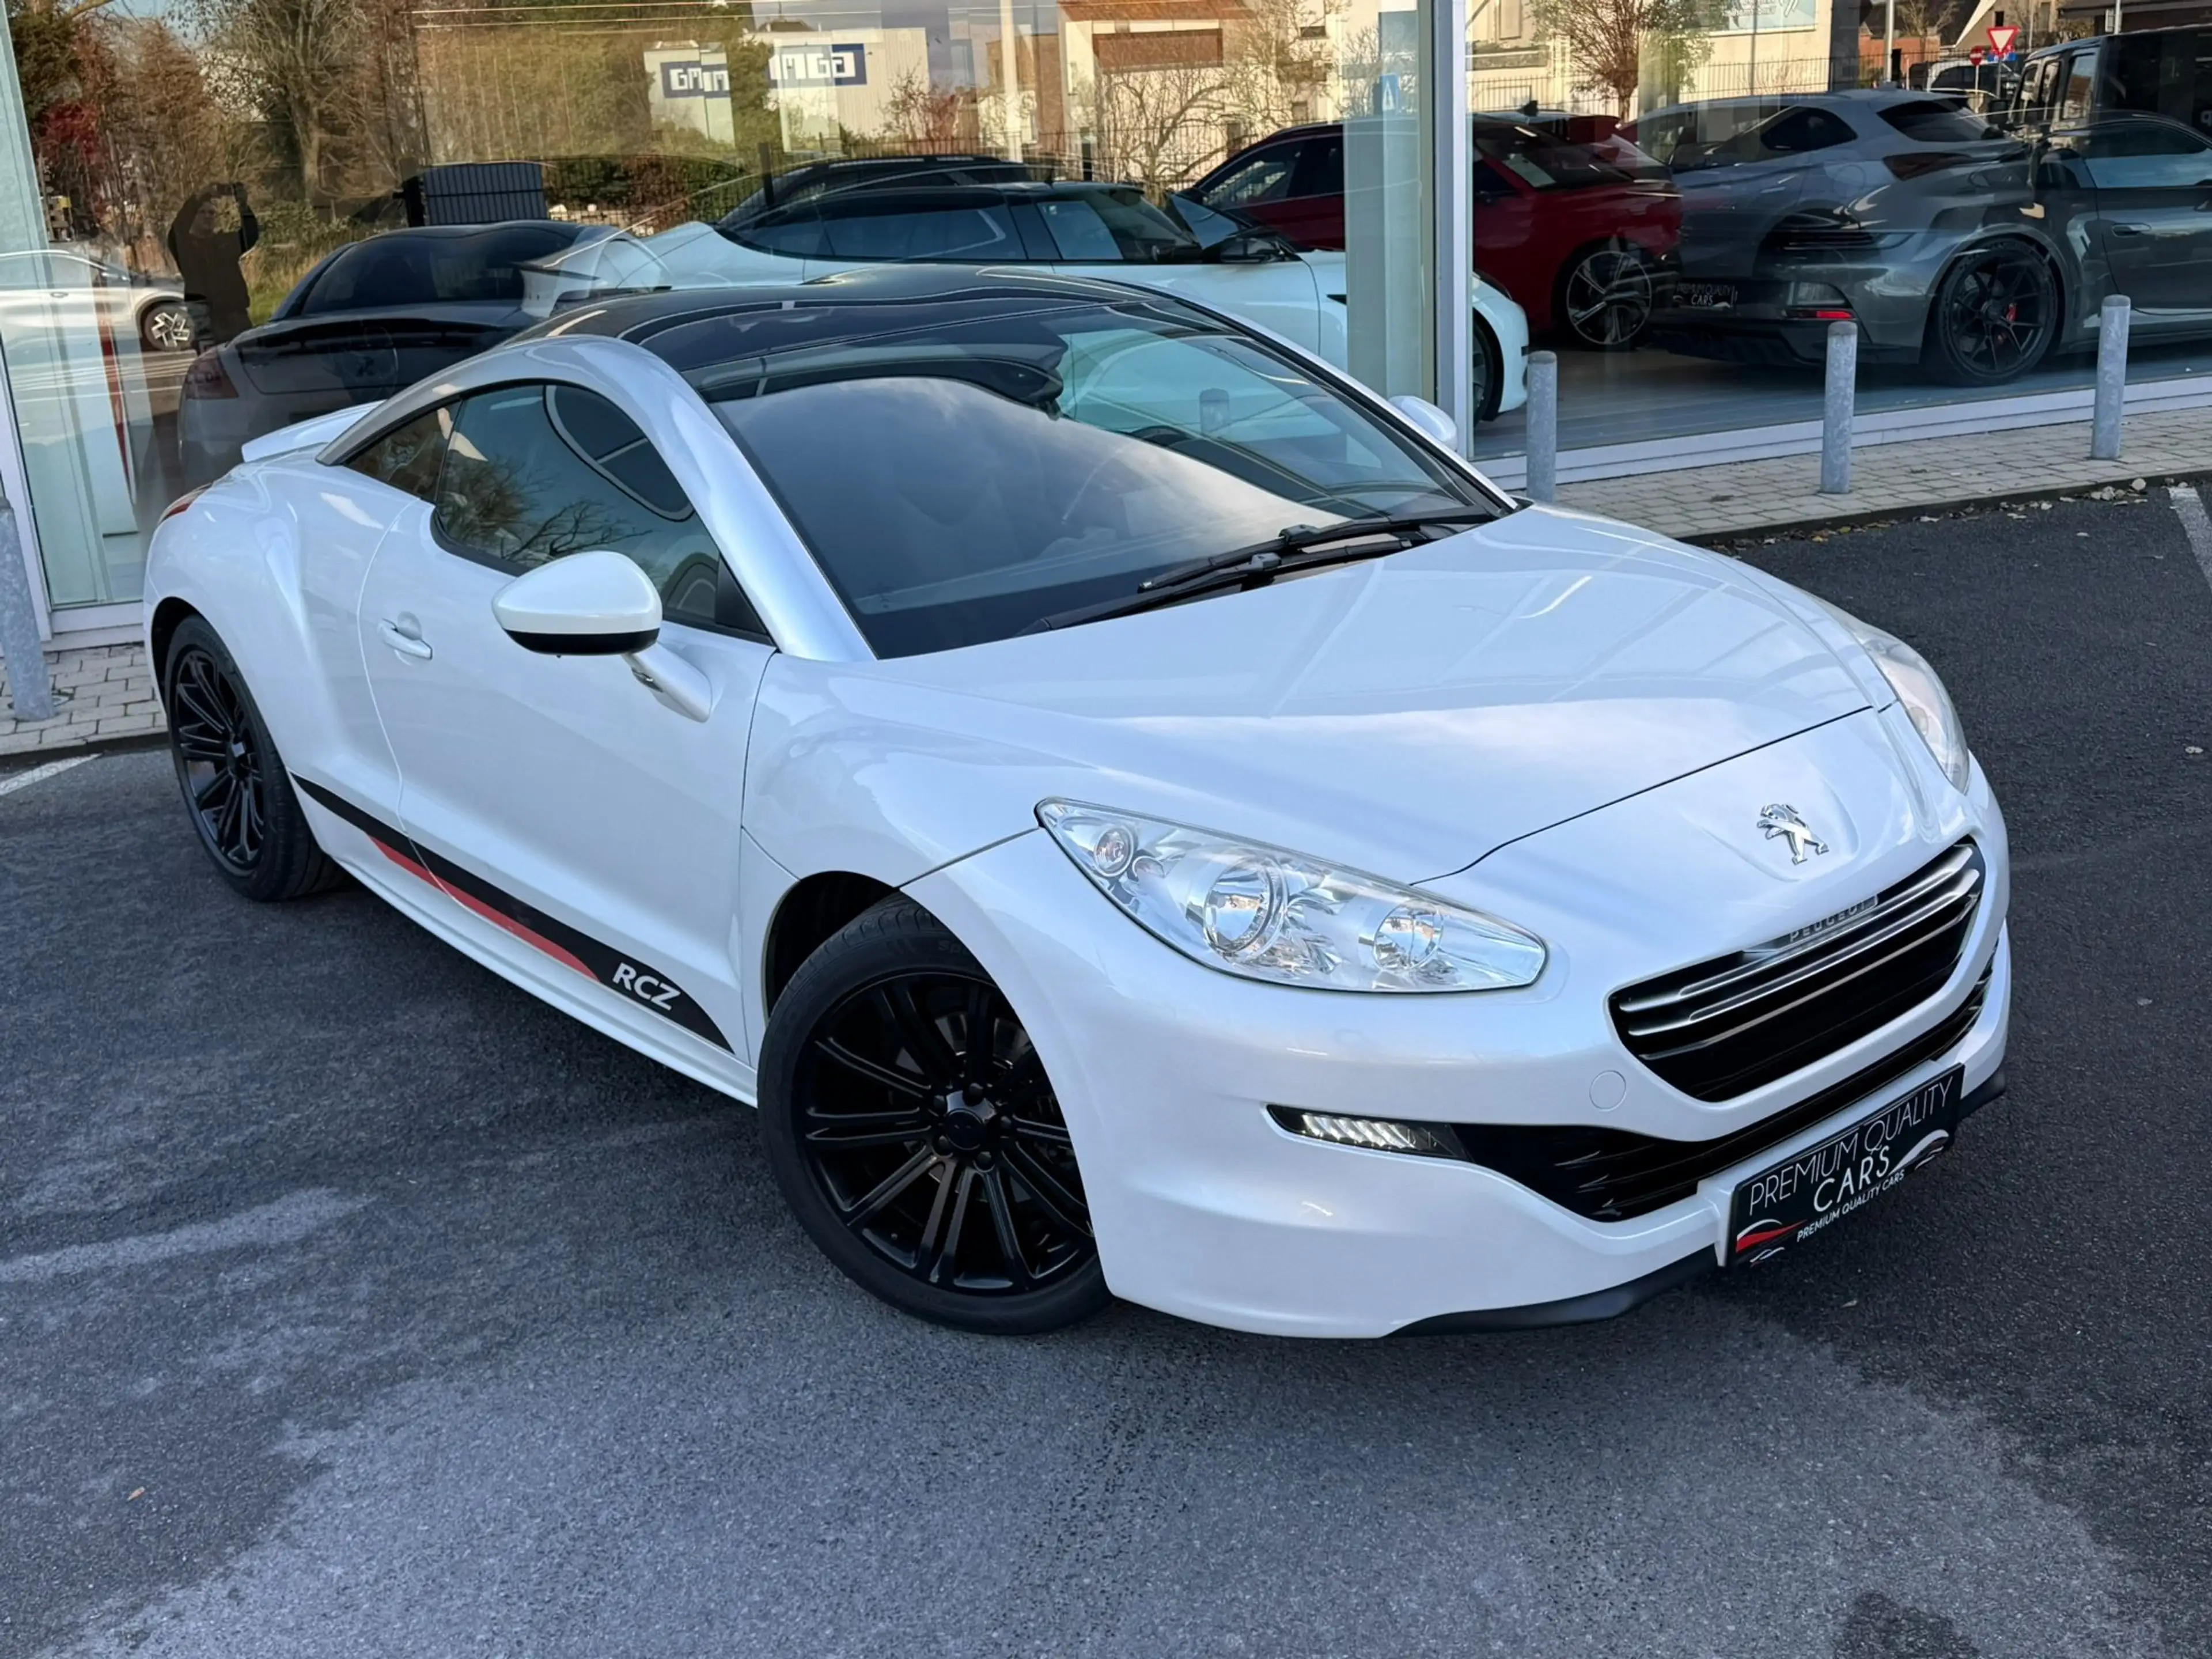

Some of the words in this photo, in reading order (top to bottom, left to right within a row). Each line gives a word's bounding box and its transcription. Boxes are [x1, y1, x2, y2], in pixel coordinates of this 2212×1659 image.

[1691, 294, 1713, 306] CARS
[612, 961, 681, 1012] RCZ
[1749, 1132, 1859, 1217] PREMIUM
[1864, 1076, 1953, 1152] QUALITY
[1813, 1145, 1890, 1212] CARS
[1797, 1208, 1840, 1243] PREMIUM
[1842, 1183, 1881, 1215] QUALITY
[1882, 1169, 1905, 1191] CARS
